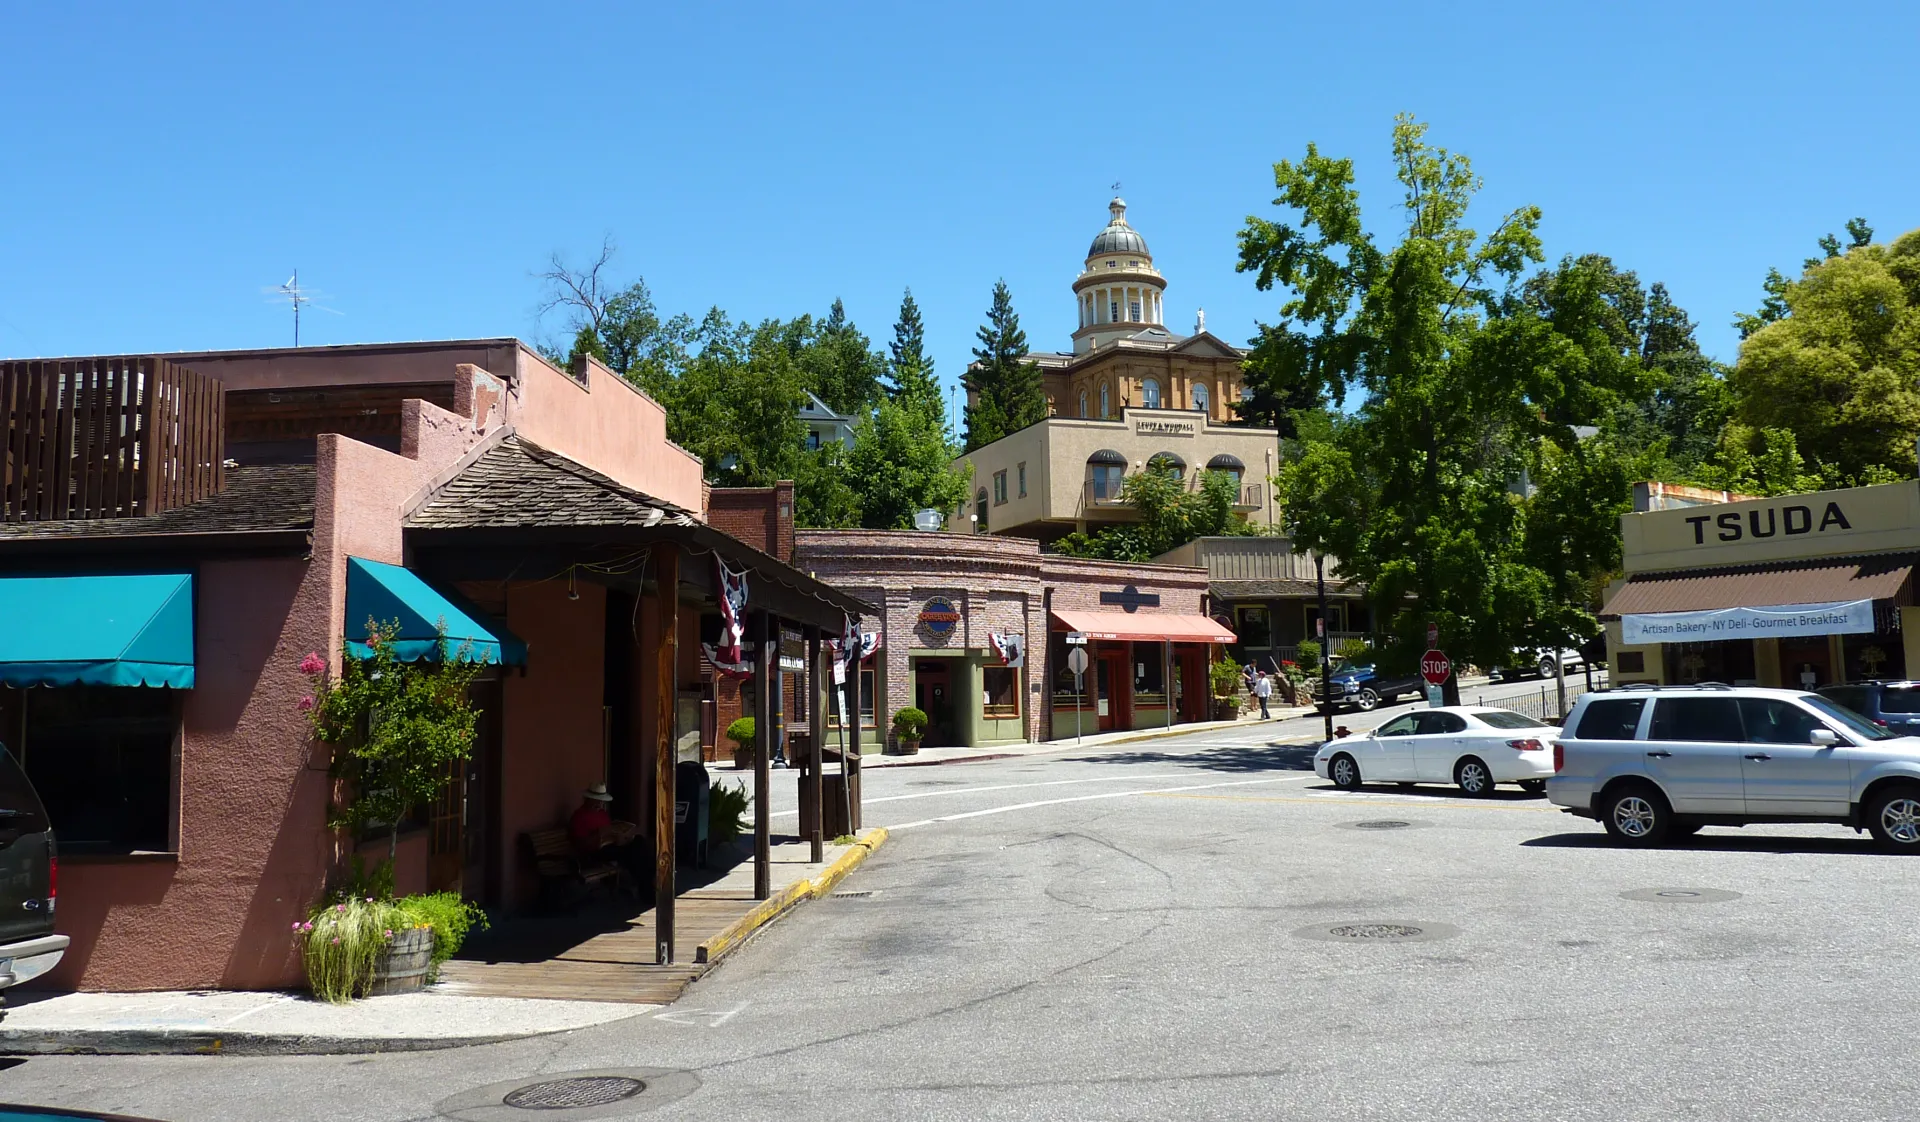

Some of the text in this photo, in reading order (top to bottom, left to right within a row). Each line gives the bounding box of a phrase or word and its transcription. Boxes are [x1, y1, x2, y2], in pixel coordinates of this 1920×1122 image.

[1685, 502, 1852, 544] TSUDA
[1642, 624, 1674, 635] Artisan
[1800, 613, 1848, 626] Breakfast
[1422, 660, 1448, 674] STOP
